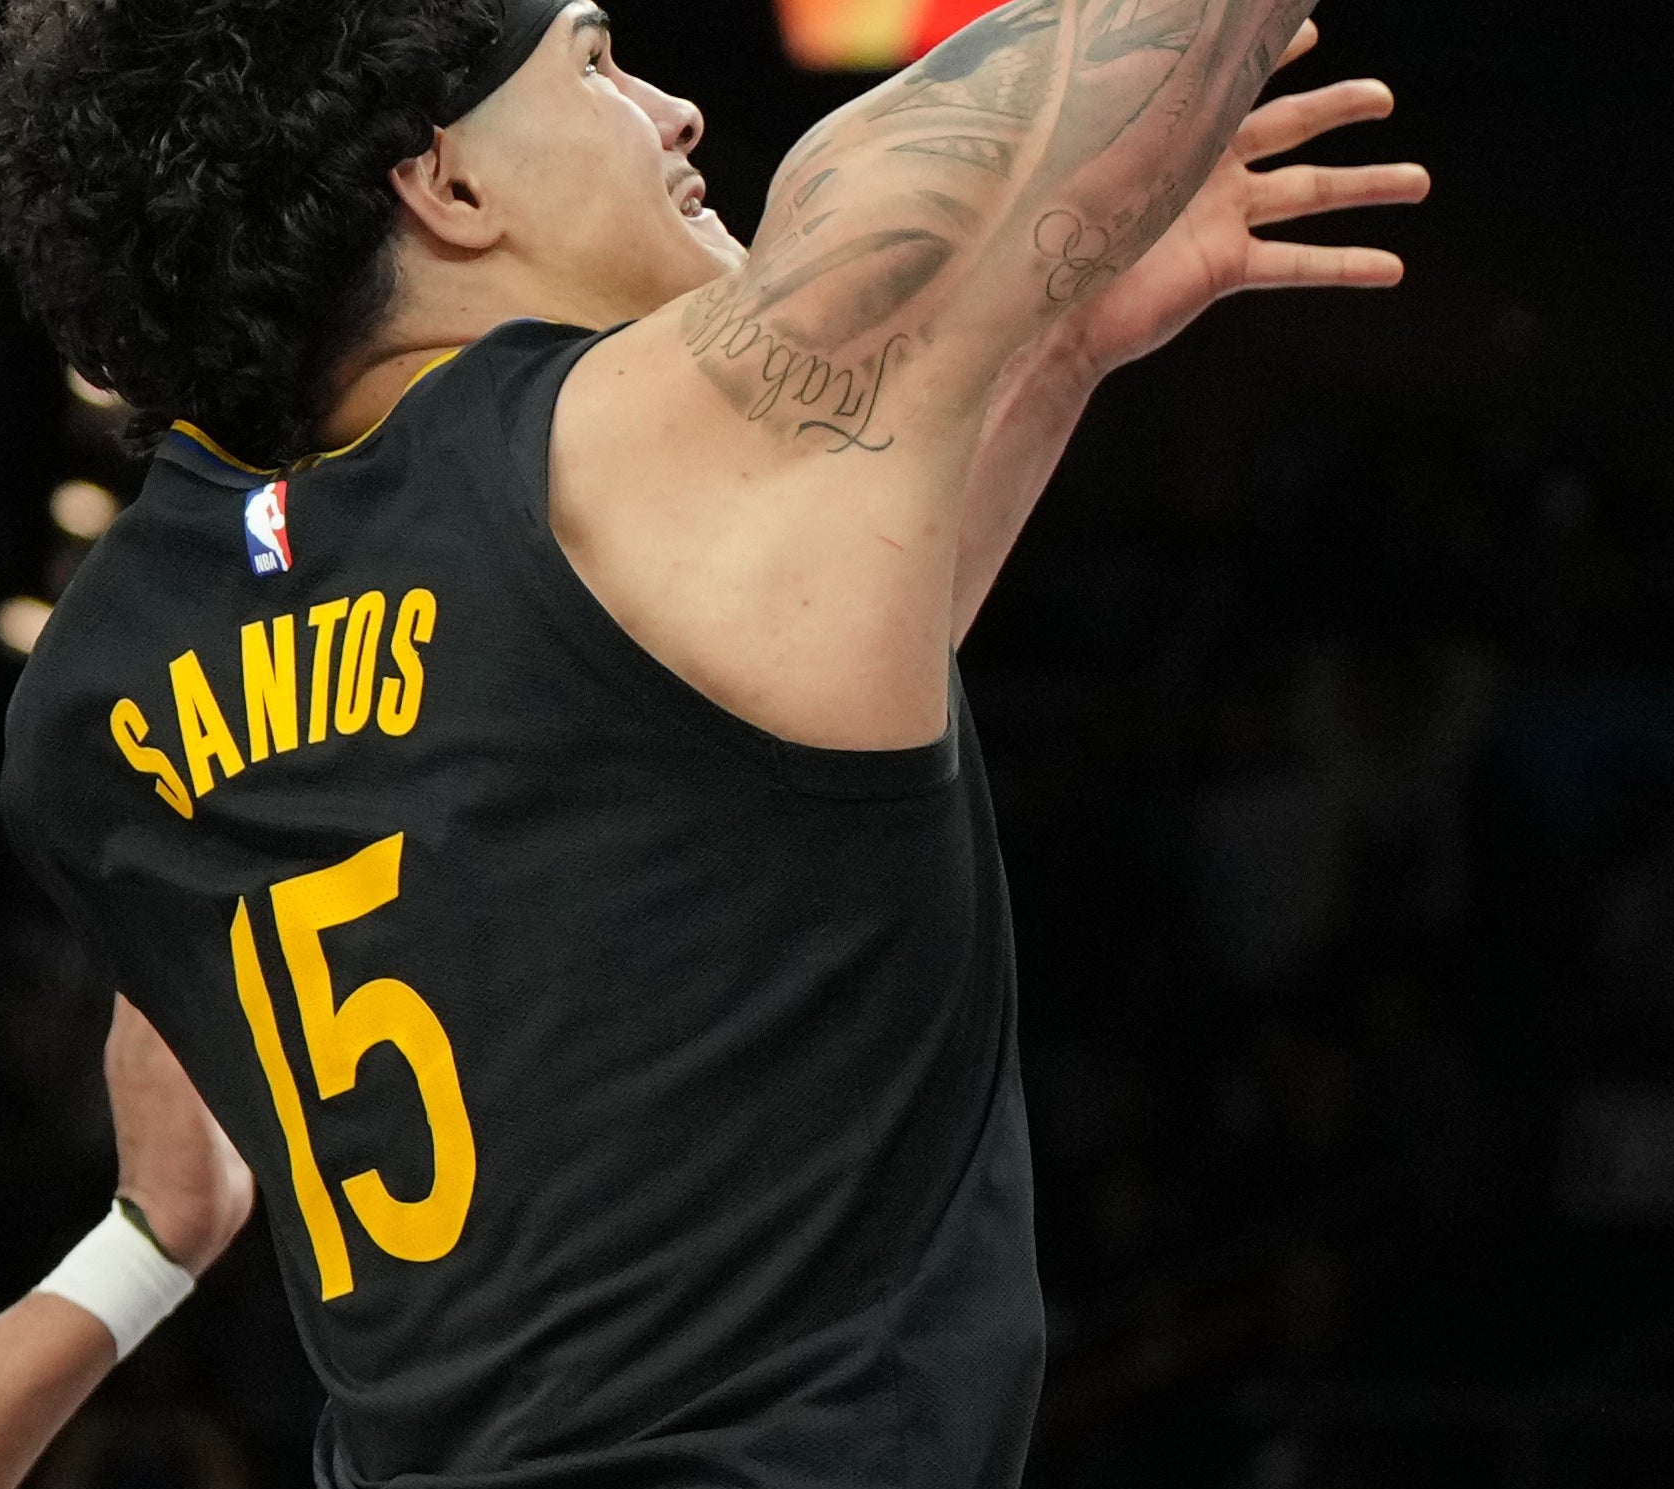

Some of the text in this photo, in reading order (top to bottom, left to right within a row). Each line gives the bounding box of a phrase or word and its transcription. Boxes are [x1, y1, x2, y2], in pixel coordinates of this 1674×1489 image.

[253, 550, 279, 573] NBA
[110, 588, 437, 820] SANTOS
[229, 831, 476, 1303] 15
